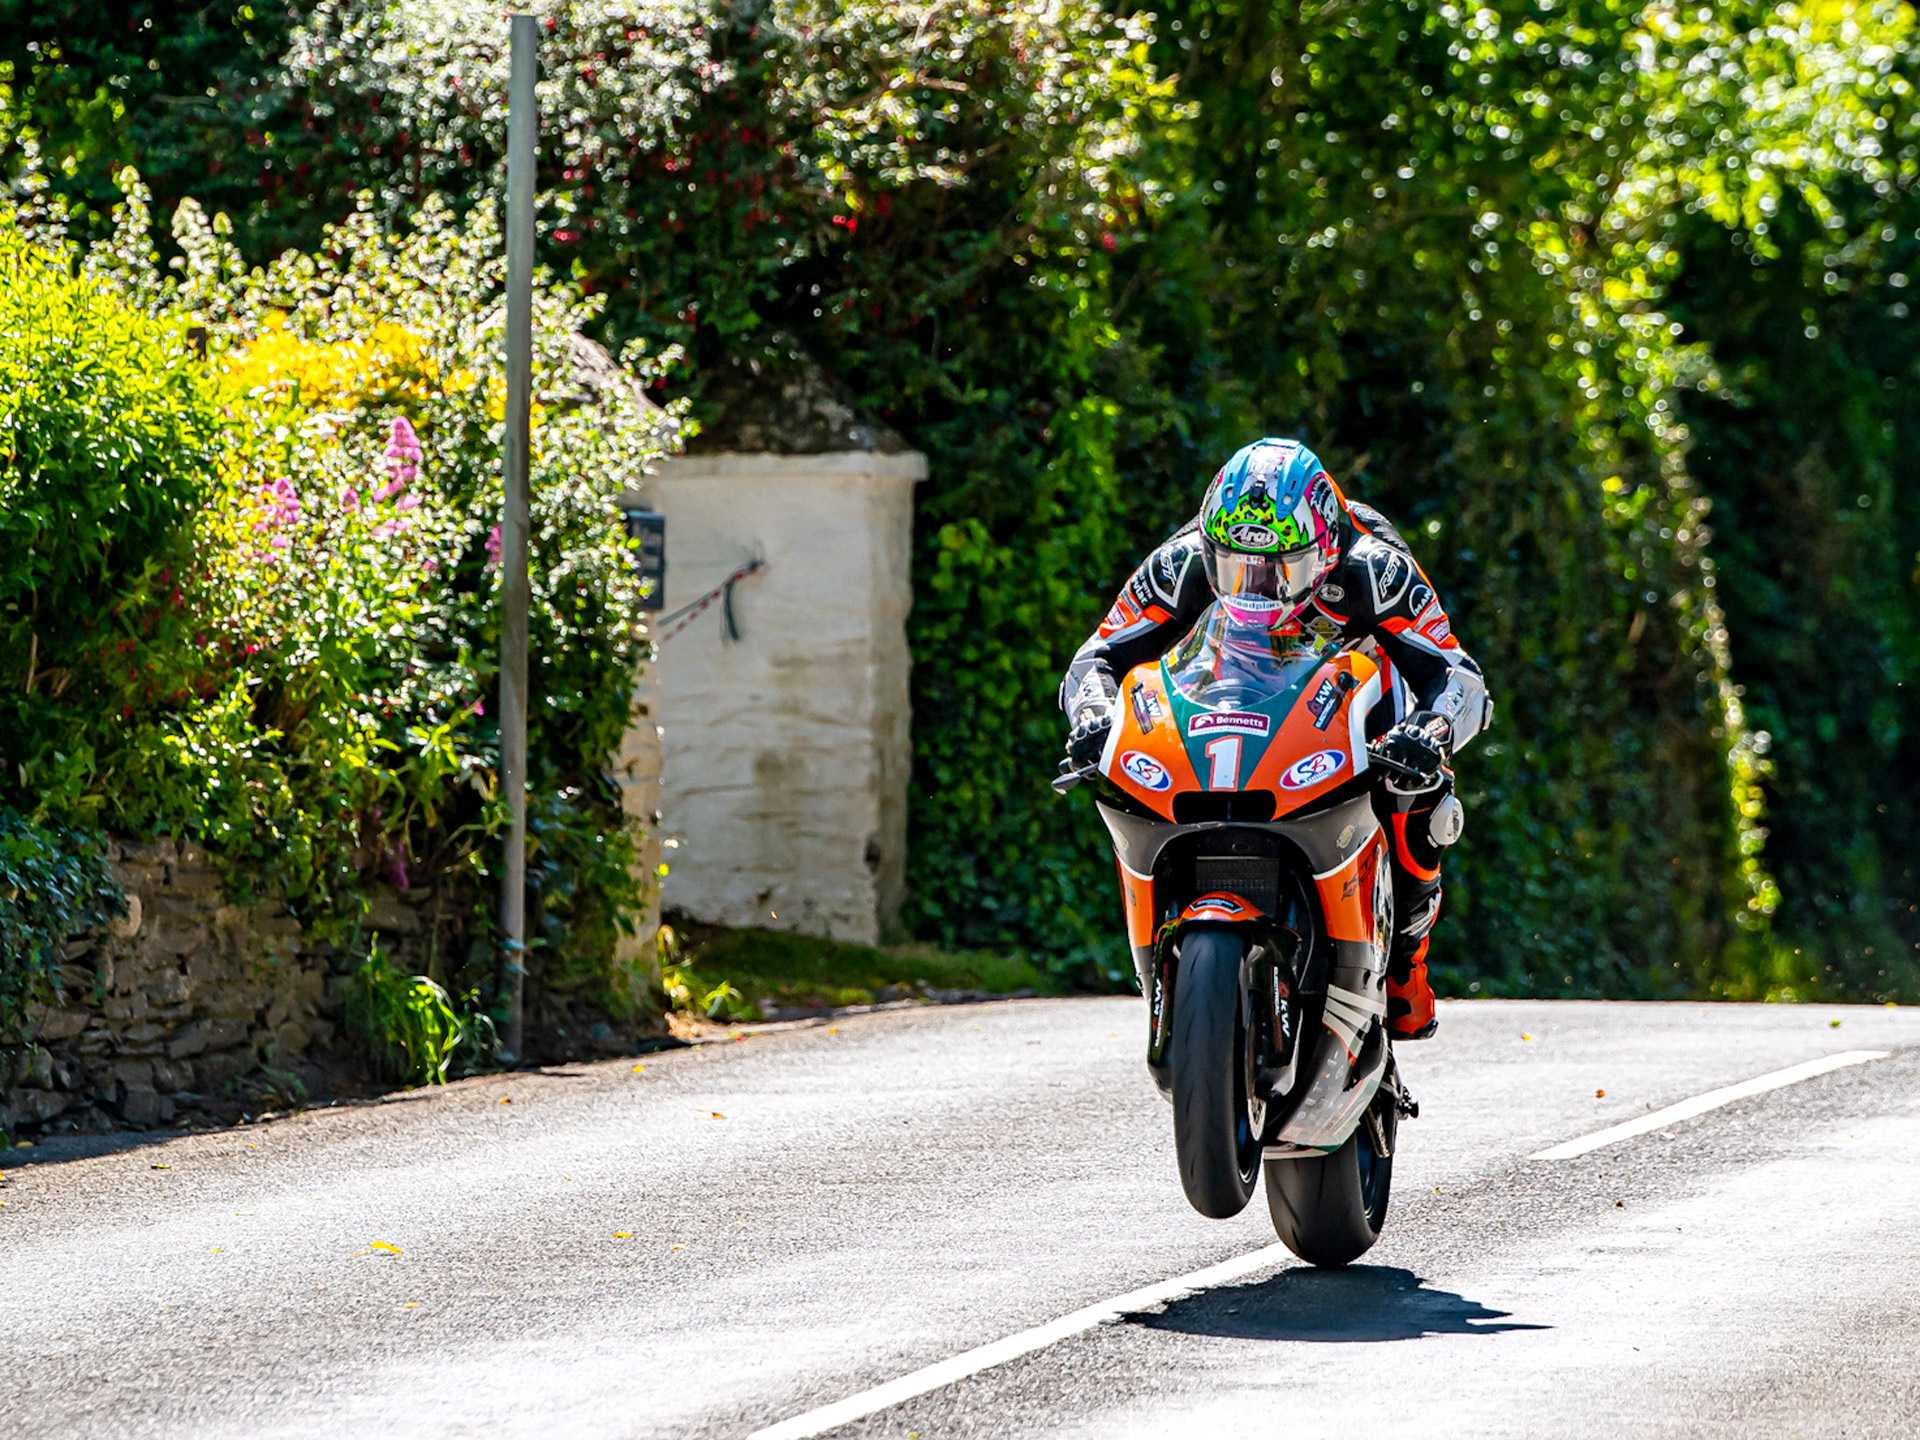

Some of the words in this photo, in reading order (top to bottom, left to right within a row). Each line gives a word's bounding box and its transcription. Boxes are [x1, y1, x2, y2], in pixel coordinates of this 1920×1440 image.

[1231, 526, 1272, 543] Arai
[1160, 549, 1177, 587] ST
[1379, 551, 1401, 599] RST
[1414, 589, 1433, 614] MAN
[1315, 680, 1333, 705] kW
[1216, 716, 1264, 727] Bennetts
[1206, 736, 1242, 791] 1
